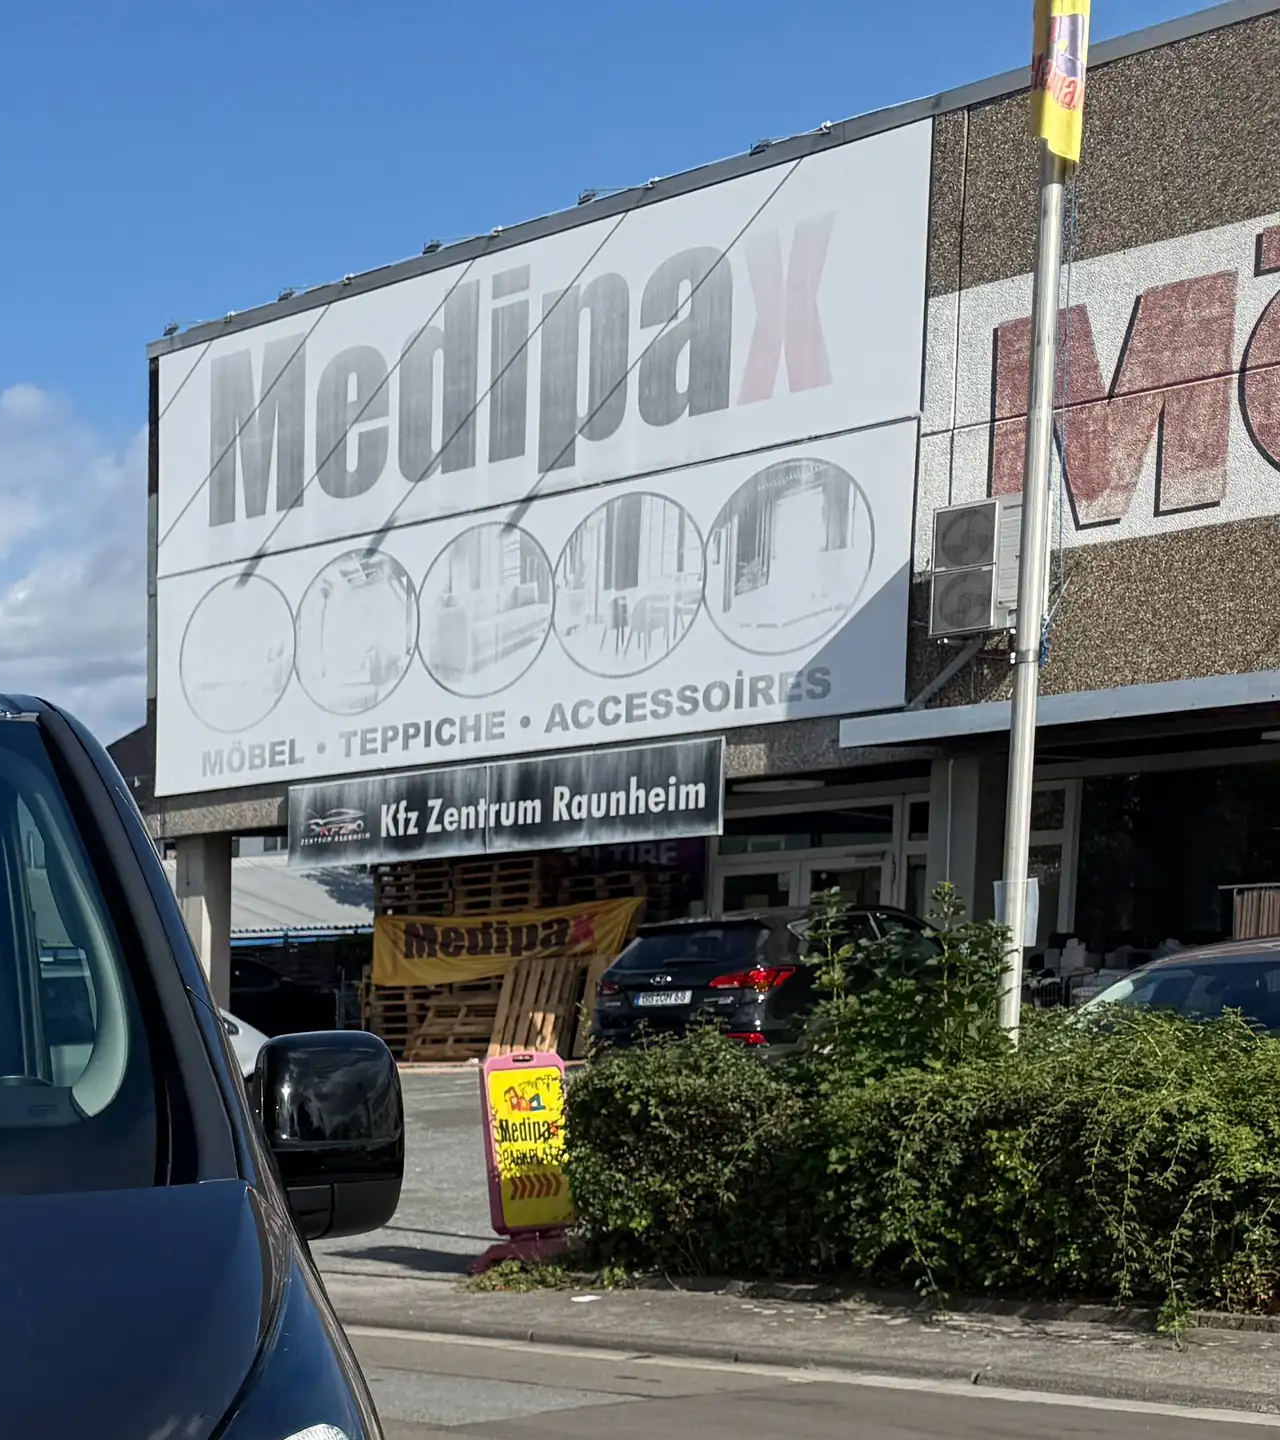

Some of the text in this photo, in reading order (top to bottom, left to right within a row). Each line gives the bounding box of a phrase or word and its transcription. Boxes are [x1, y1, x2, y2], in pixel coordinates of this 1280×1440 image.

[209, 212, 834, 527] Medipax
[986, 225, 1280, 530] M
[201, 738, 304, 777] MÖBEL
[339, 710, 506, 757] TEPPICHE
[381, 776, 706, 838] Kfz Zentrum Raunheim
[404, 914, 596, 959] Medipax
